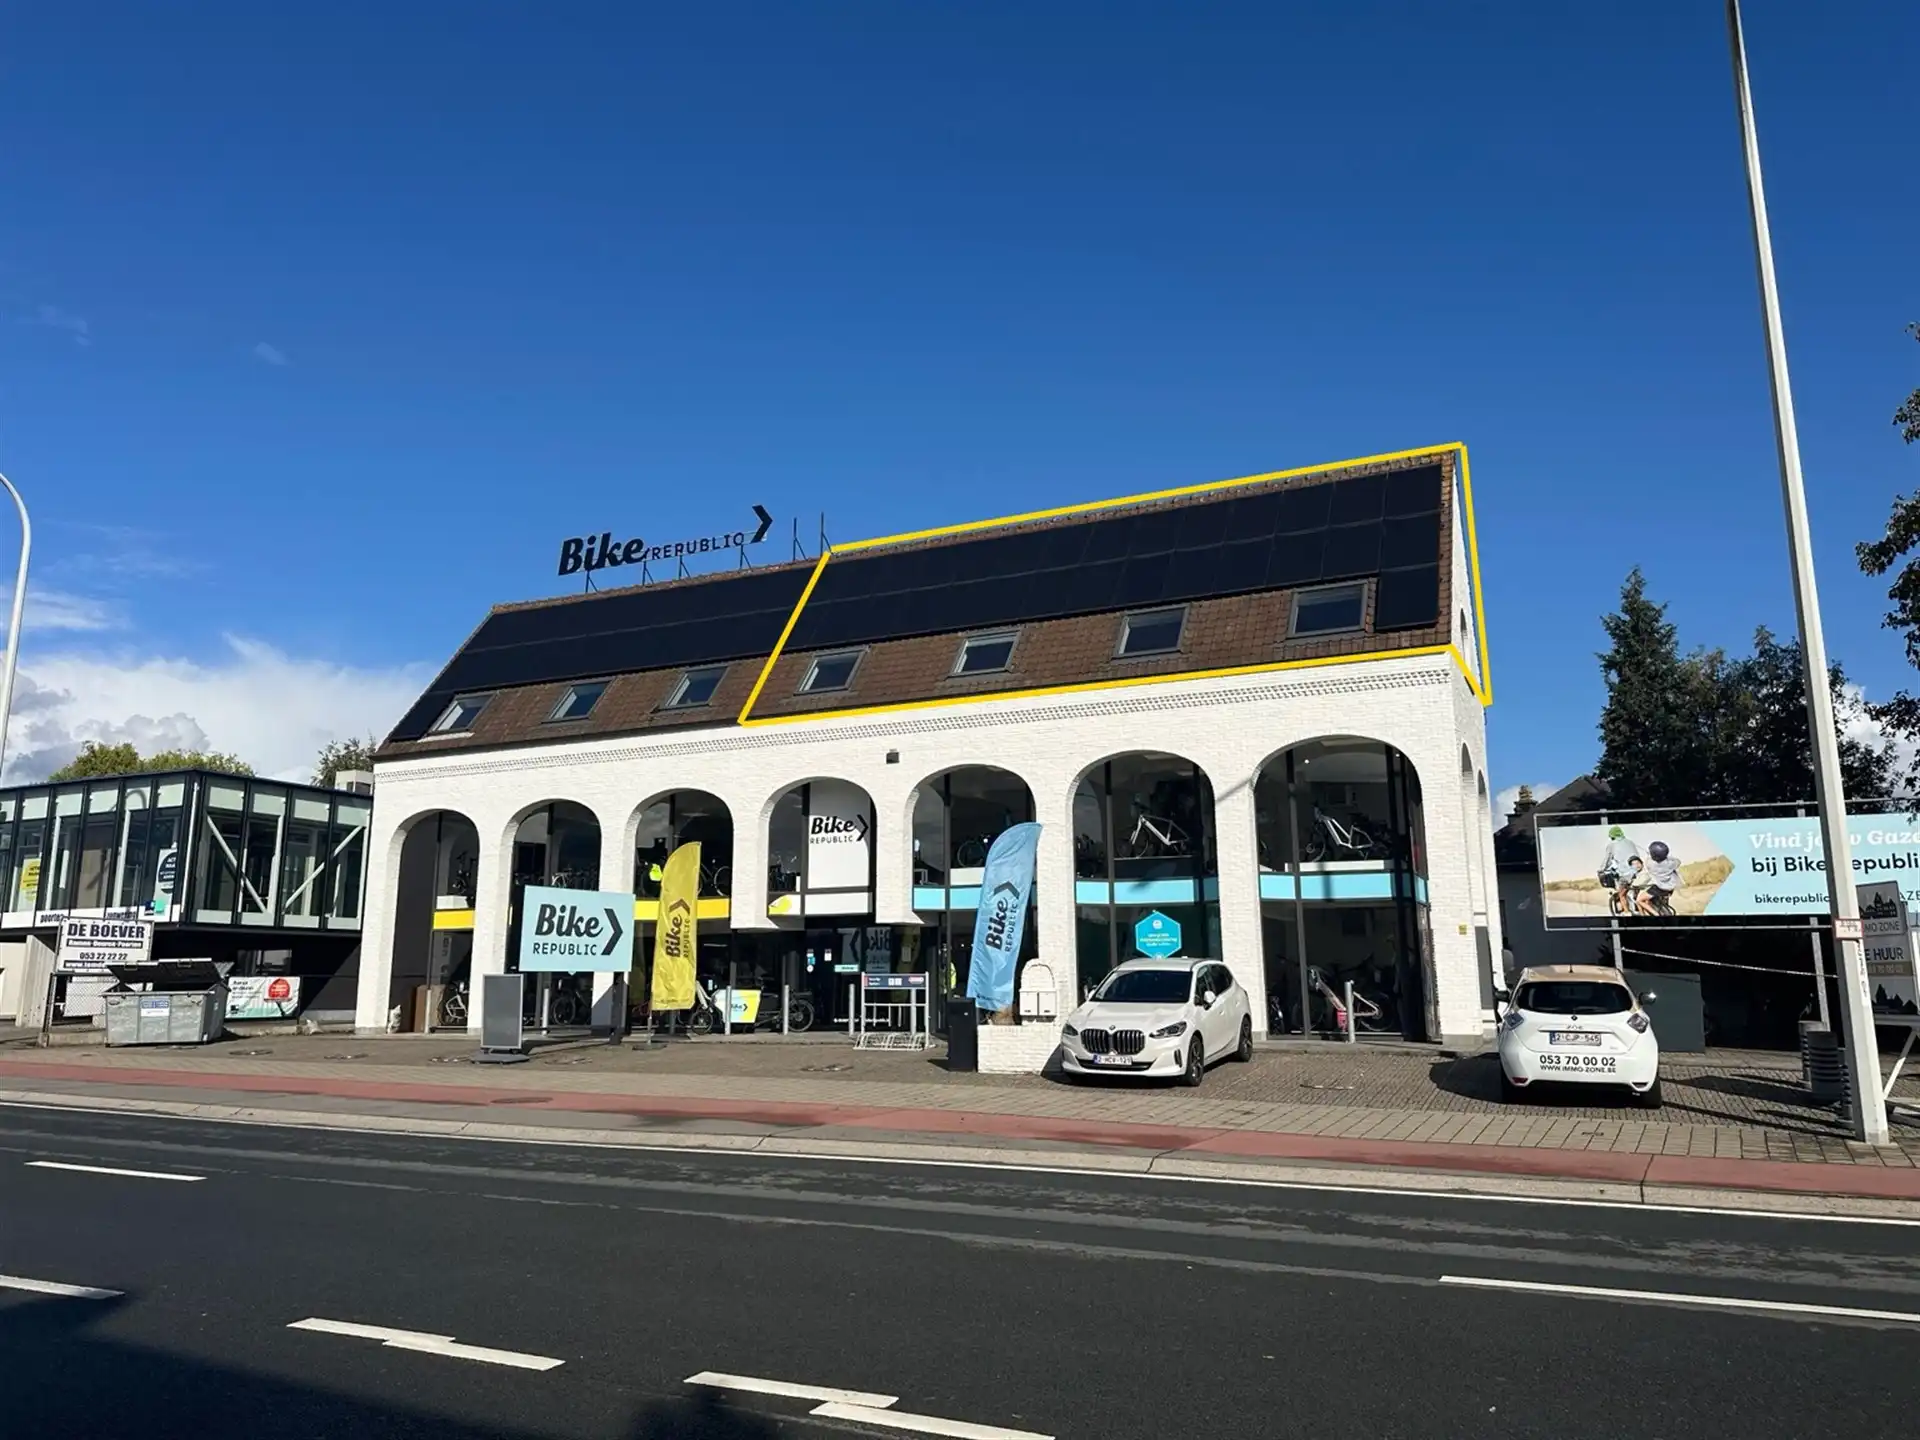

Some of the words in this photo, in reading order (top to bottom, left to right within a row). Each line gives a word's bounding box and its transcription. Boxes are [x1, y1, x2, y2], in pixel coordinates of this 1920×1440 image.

[557, 532, 650, 576] Bike
[650, 531, 745, 560] REPUBLIC
[811, 816, 857, 835] Bike
[810, 836, 853, 844] REPUBLIC
[1748, 832, 1802, 849] Vind
[1751, 856, 1777, 877] bij
[1784, 856, 1827, 872] Bike
[534, 903, 604, 938] Bike
[985, 897, 1009, 951] Bike
[1004, 903, 1018, 953] REPUBLIC
[1879, 921, 1900, 933] ZONE
[67, 923, 87, 936] DE
[90, 924, 145, 938] BOEVER
[665, 914, 683, 958] Bike
[80, 952, 95, 960] 053
[97, 952, 106, 960] 22
[533, 942, 597, 955] REPUBLIC
[1873, 947, 1904, 960] HUUR
[1539, 1055, 1561, 1064] 053
[1565, 1056, 1580, 1065] 70
[1583, 1056, 1598, 1066] 00
[1601, 1057, 1616, 1067] 02
